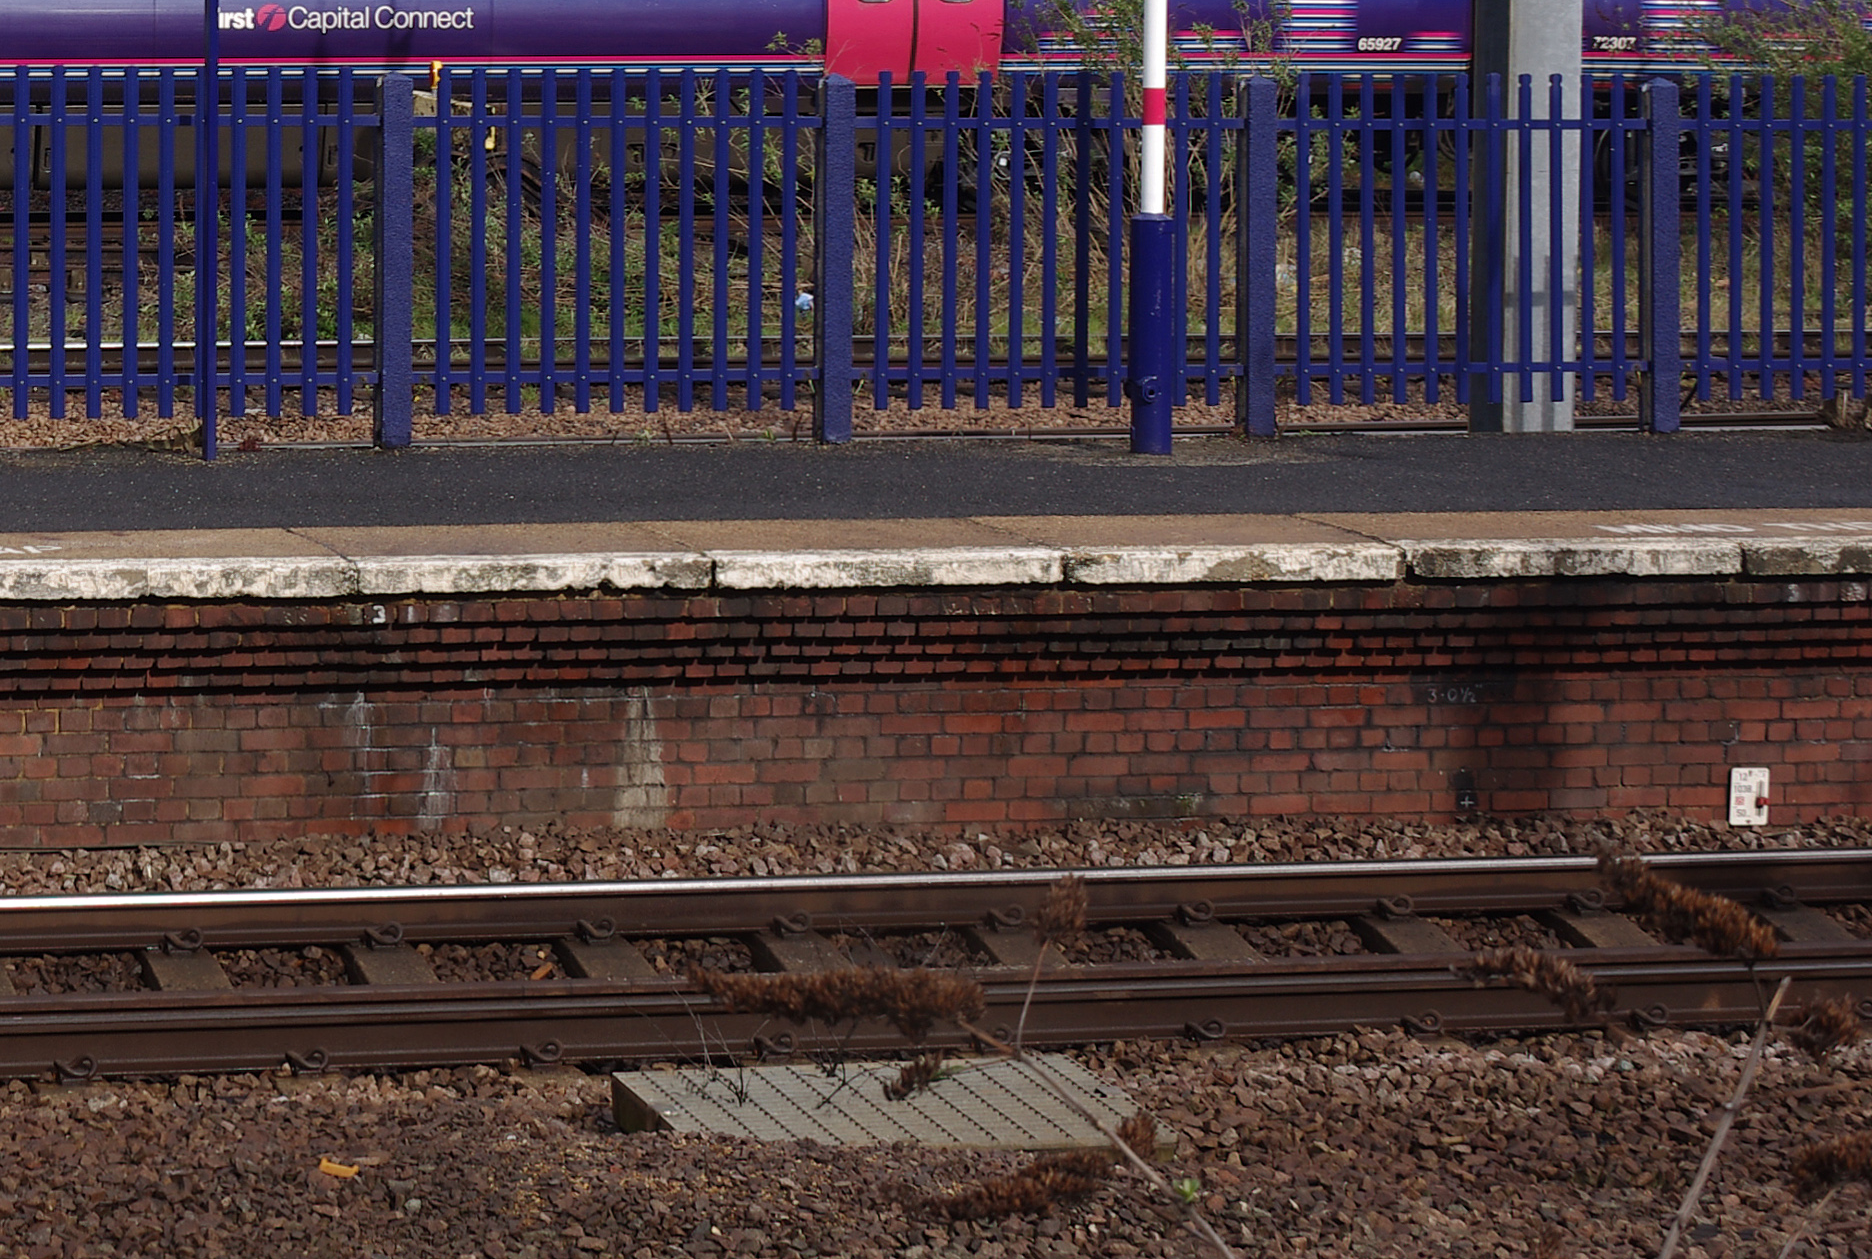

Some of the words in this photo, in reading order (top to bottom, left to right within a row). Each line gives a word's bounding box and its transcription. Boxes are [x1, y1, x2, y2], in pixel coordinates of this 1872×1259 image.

[217, 6, 255, 29] irst
[288, 5, 369, 33] Capital
[374, 6, 474, 29] Connect
[1357, 37, 1401, 51] 65927
[1592, 36, 1637, 50] 72307
